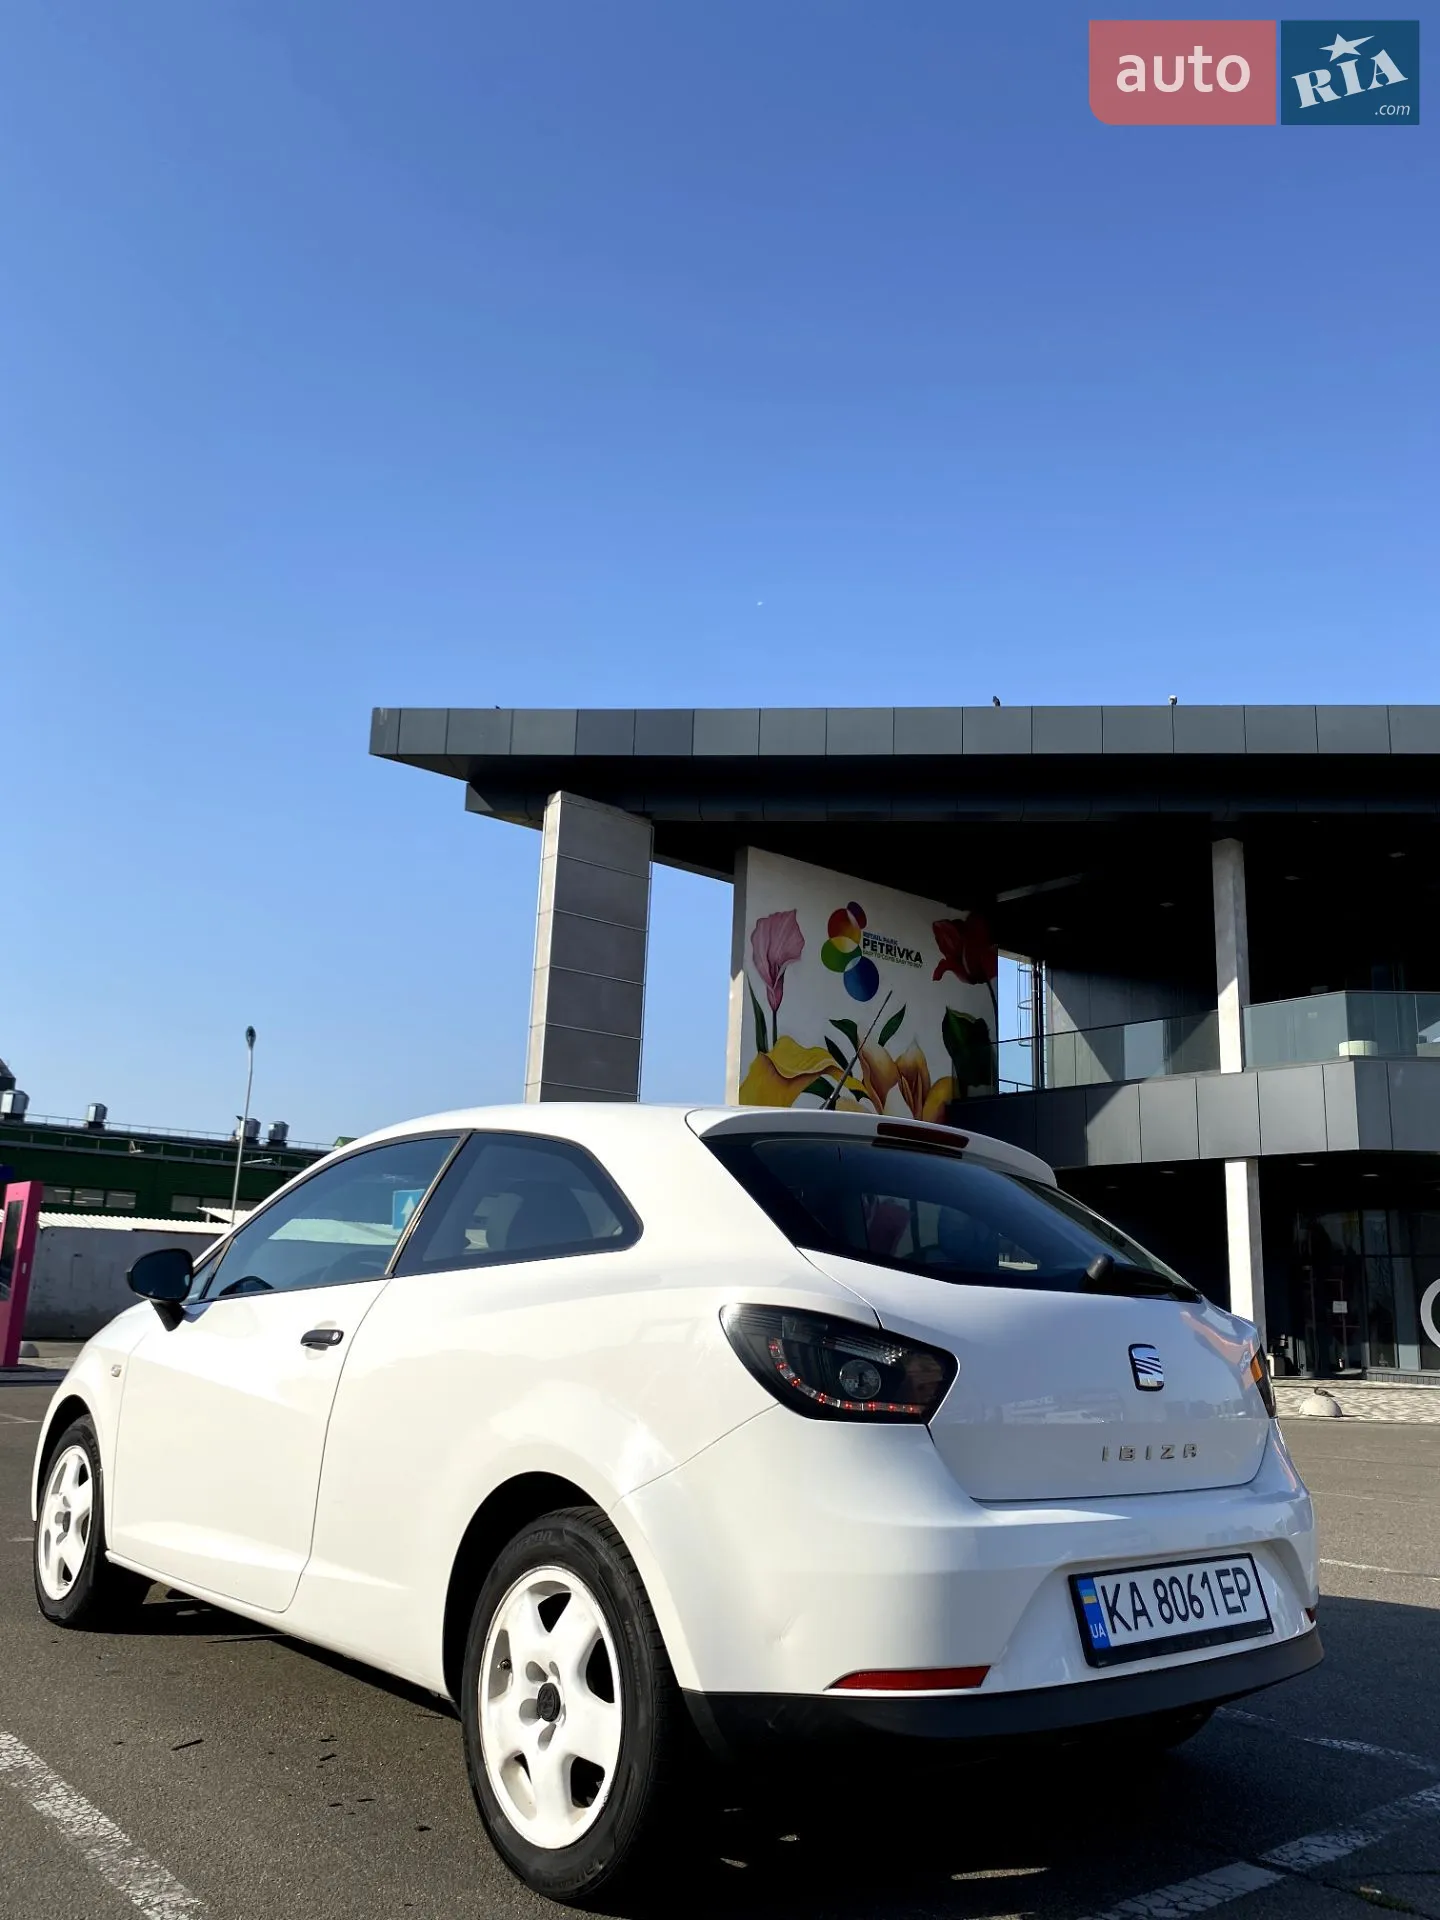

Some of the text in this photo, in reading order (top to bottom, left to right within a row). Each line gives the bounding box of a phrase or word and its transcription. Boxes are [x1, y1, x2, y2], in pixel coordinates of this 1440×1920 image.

[862, 938, 923, 963] PETRIVKA
[1101, 1443, 1198, 1462] IBIZA
[1101, 1580, 1154, 1634] KA
[1090, 1622, 1106, 1639] UA
